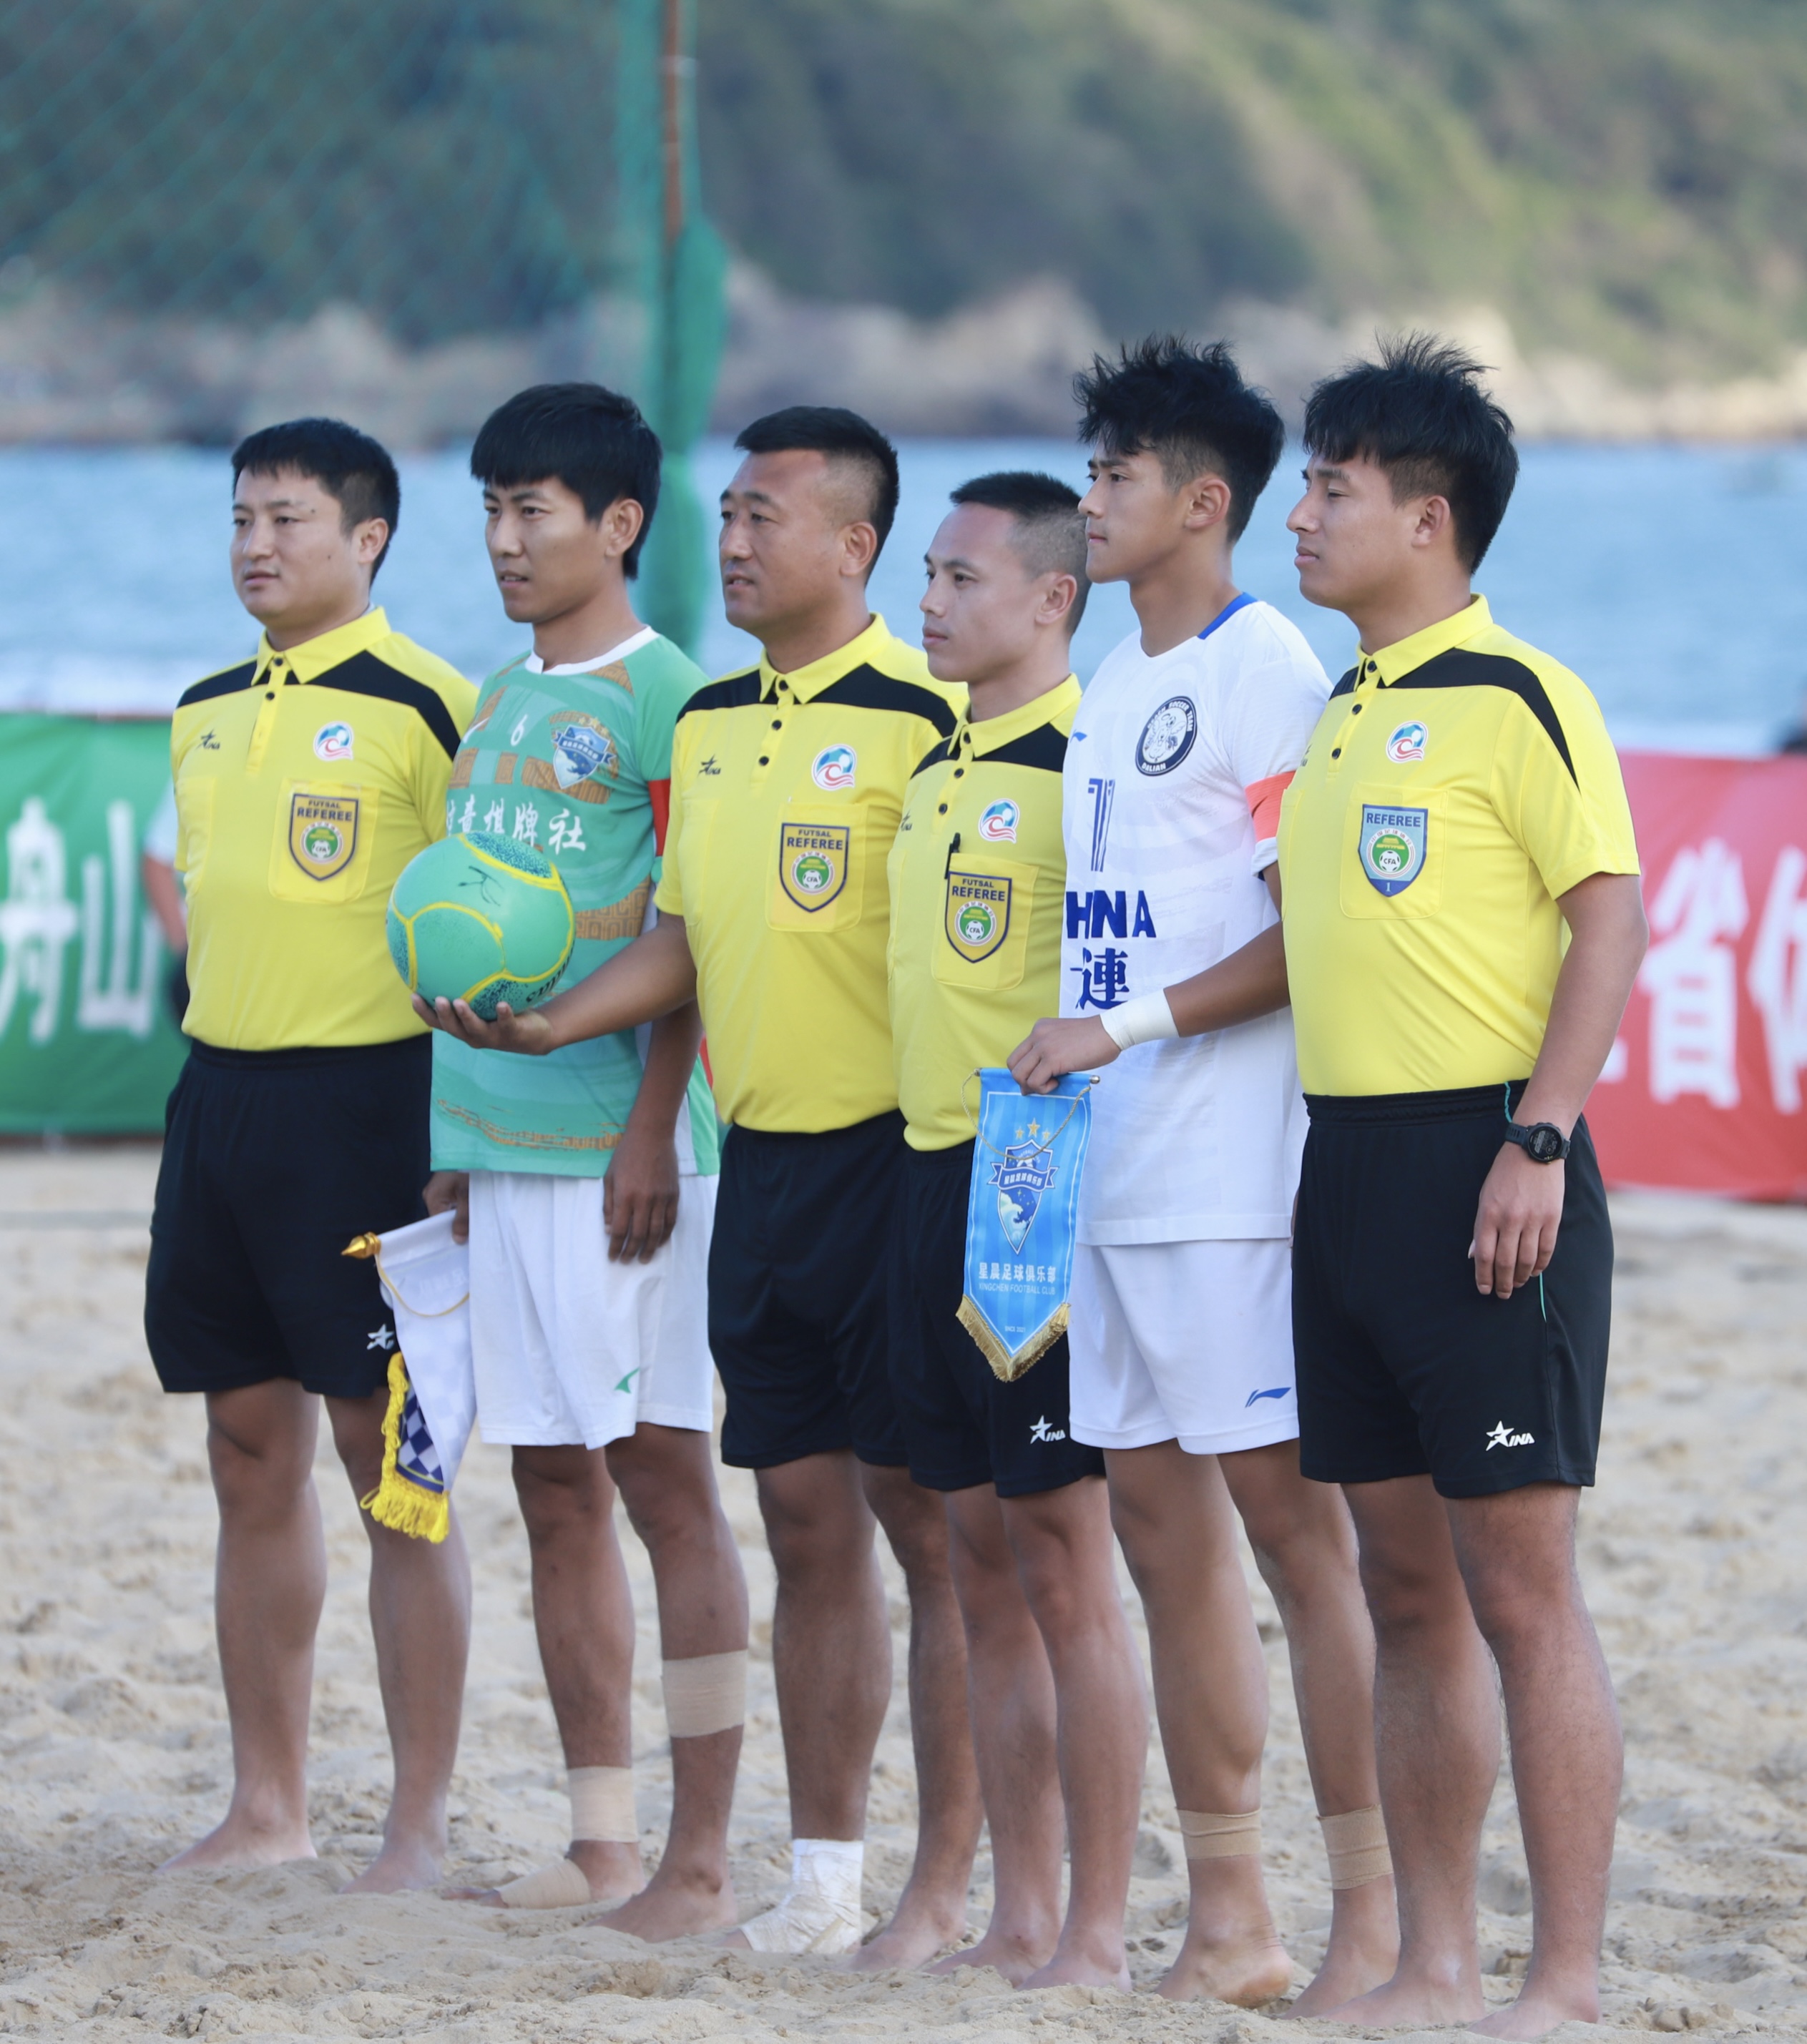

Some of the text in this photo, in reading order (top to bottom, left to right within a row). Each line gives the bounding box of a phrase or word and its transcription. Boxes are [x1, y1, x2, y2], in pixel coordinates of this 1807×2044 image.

[1168, 700, 1190, 712] SOCCER
[510, 714, 528, 747] 6
[1141, 762, 1167, 772] DALIAN
[308, 800, 341, 809] FUTSAL
[297, 807, 352, 822] REFEREE
[1366, 812, 1421, 827] REFEREE
[798, 829, 831, 837] FUTSAL
[787, 837, 843, 850] REFEREE
[962, 878, 994, 888] FUTSAL
[952, 885, 1005, 901] REFEREE
[979, 1262, 1057, 1284] 星晨足球俱乐部
[978, 1282, 1056, 1295] XINGCHEN FOOTBALL CLUB
